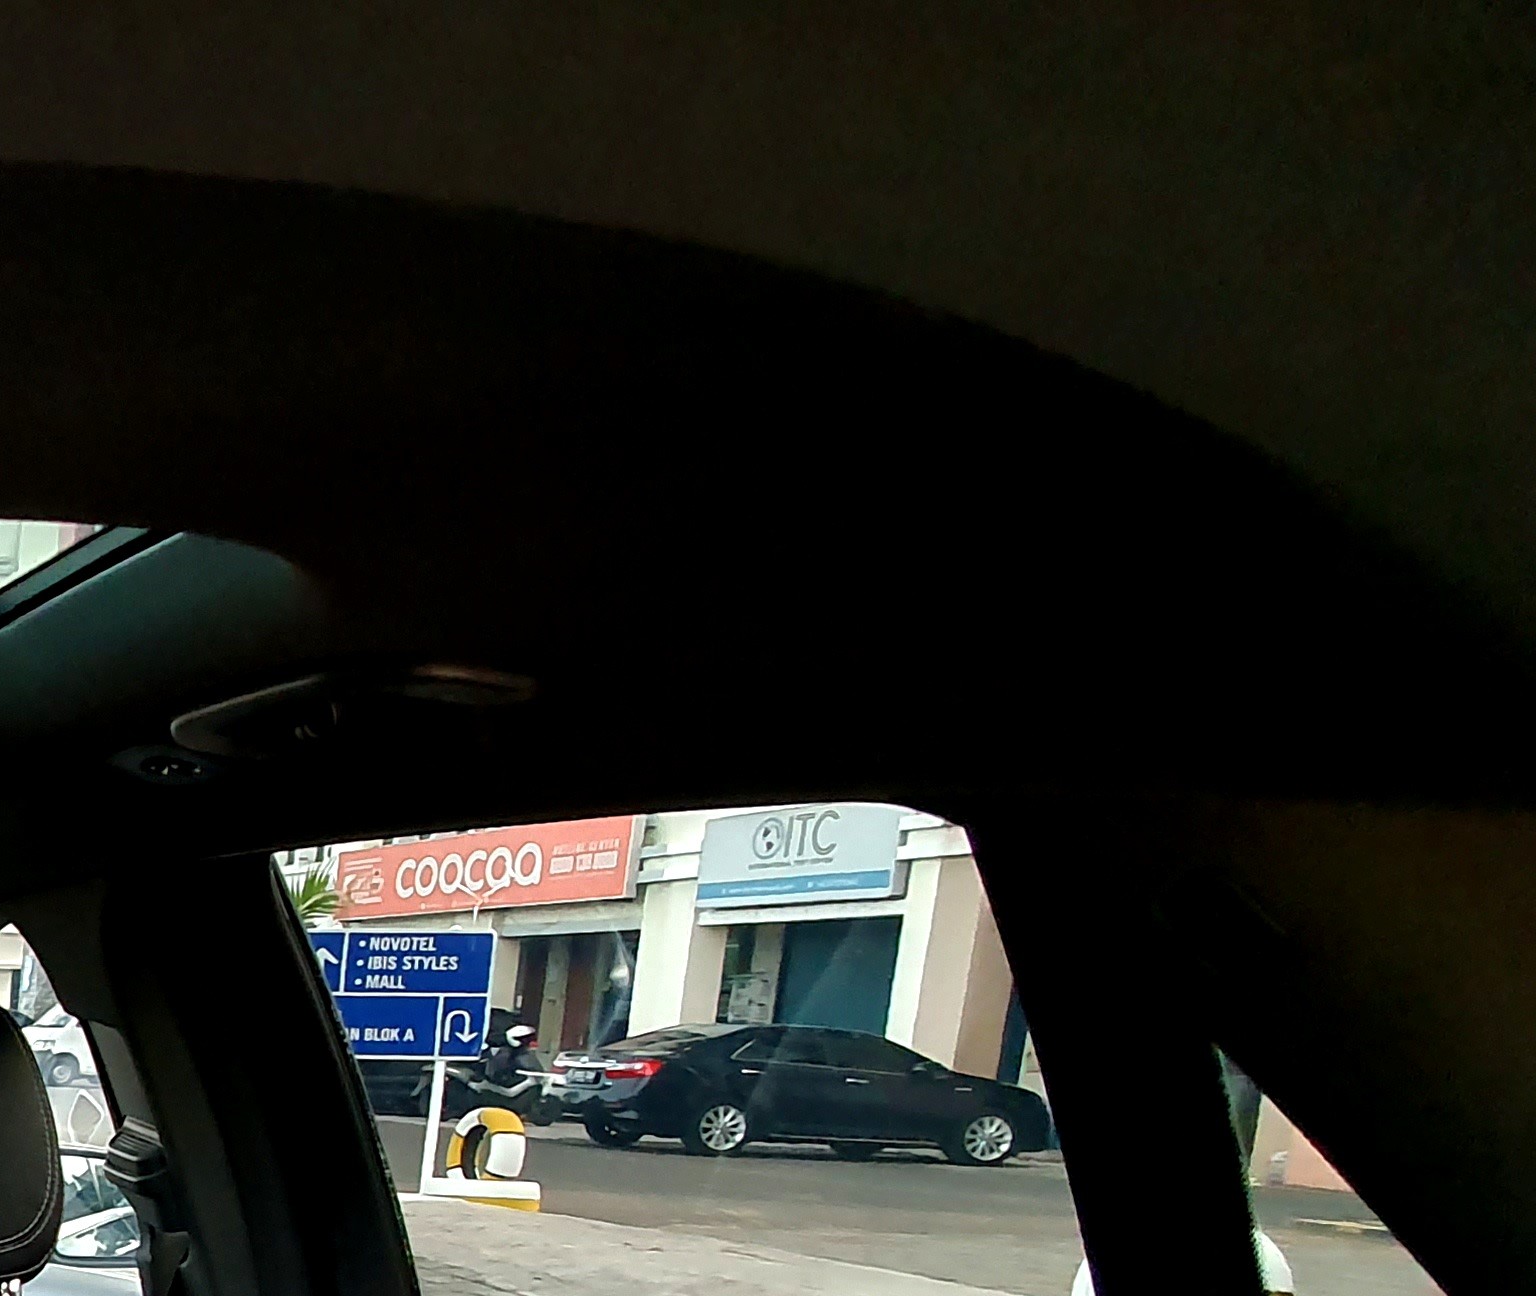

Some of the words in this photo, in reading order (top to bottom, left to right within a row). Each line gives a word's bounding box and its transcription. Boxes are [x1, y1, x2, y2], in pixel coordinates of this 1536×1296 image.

[783, 809, 841, 859] ITC
[369, 936, 438, 952] NOVOTEL
[367, 955, 398, 971] IBIS
[401, 955, 460, 971] STYLES
[364, 974, 407, 990] MALL
[363, 1027, 401, 1042] BLOK
[402, 1027, 415, 1042] A
